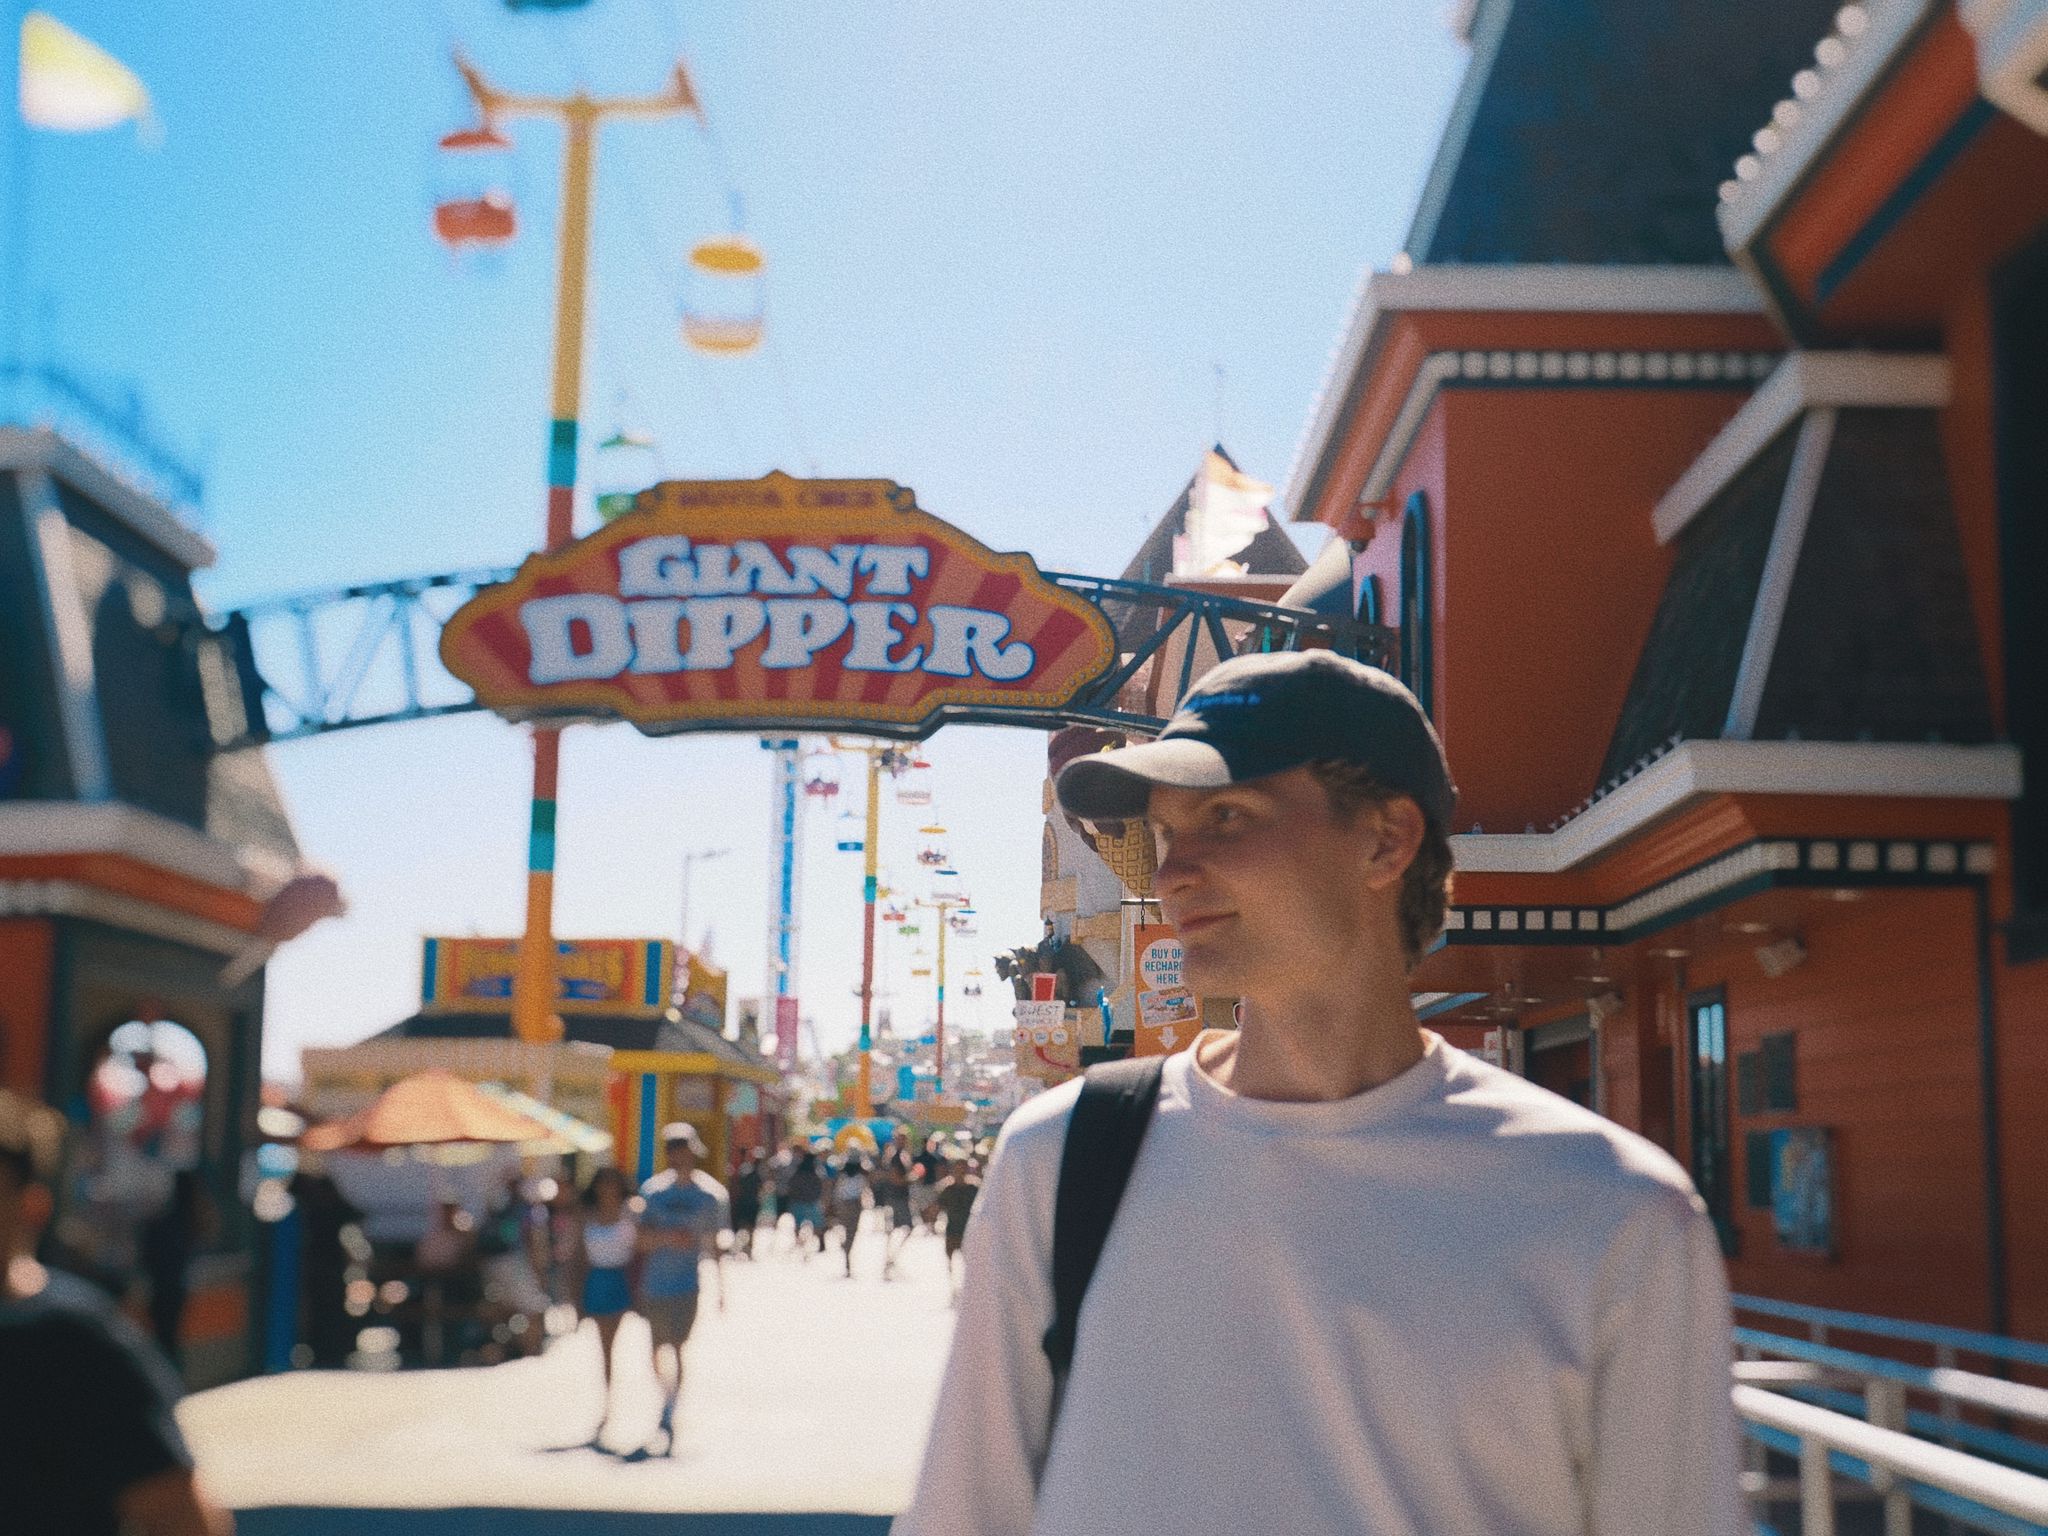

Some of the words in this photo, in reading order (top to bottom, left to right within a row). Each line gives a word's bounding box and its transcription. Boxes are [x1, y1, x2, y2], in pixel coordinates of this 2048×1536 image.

[619, 534, 930, 600] GIANT
[520, 592, 1035, 685] DIPPER
[1151, 948, 1169, 959] BUY
[1156, 973, 1179, 984] HERE
